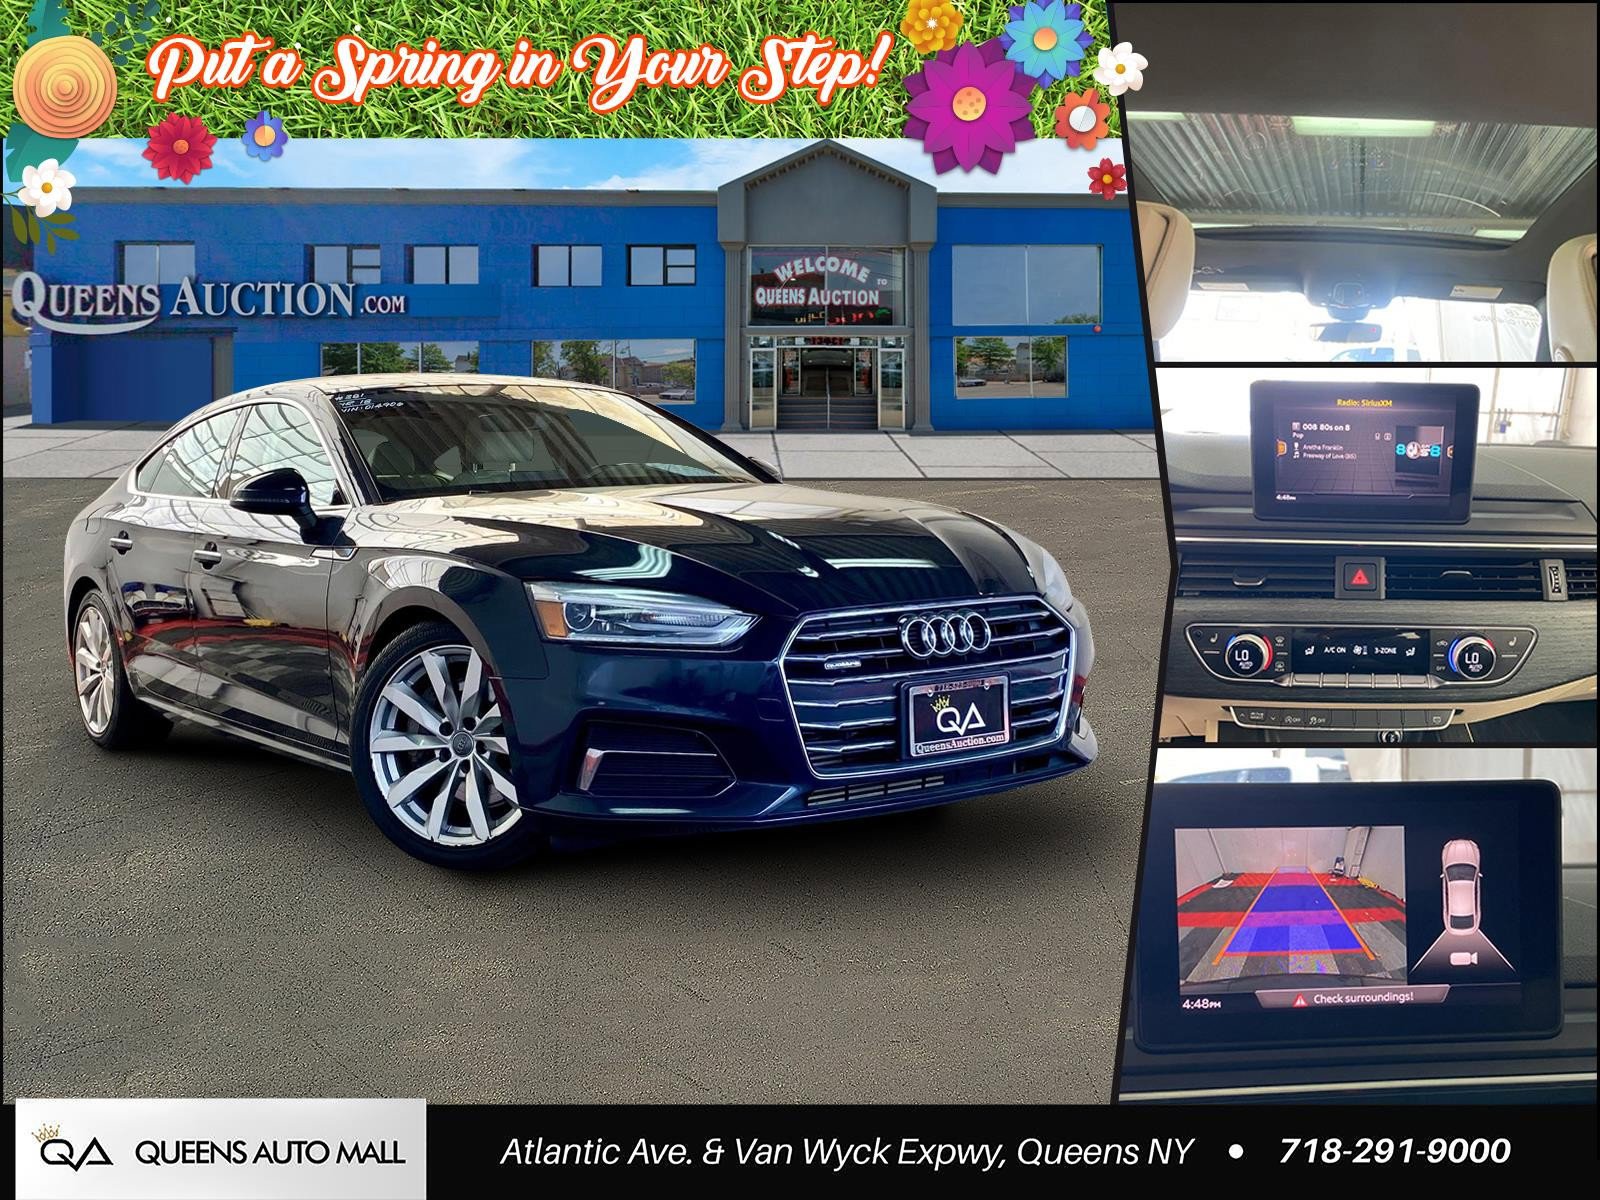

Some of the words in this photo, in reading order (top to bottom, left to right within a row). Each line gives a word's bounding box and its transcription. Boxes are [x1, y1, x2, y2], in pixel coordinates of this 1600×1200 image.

[774, 255, 872, 284] WELCOME
[876, 277, 888, 286] TO
[12, 271, 161, 335] QUEENS
[755, 286, 806, 306] QUEENS
[807, 287, 880, 306] AUCTION
[1337, 399, 1360, 407] Radio:
[1361, 399, 1393, 408] SiriusXM
[1234, 649, 1250, 662] LO
[1464, 652, 1480, 665] LO
[916, 733, 1005, 754] QueensAuction.com
[1182, 998, 1222, 1010] 4:48PM
[1313, 993, 1344, 1005] Check
[1344, 991, 1415, 1004] surroundings!
